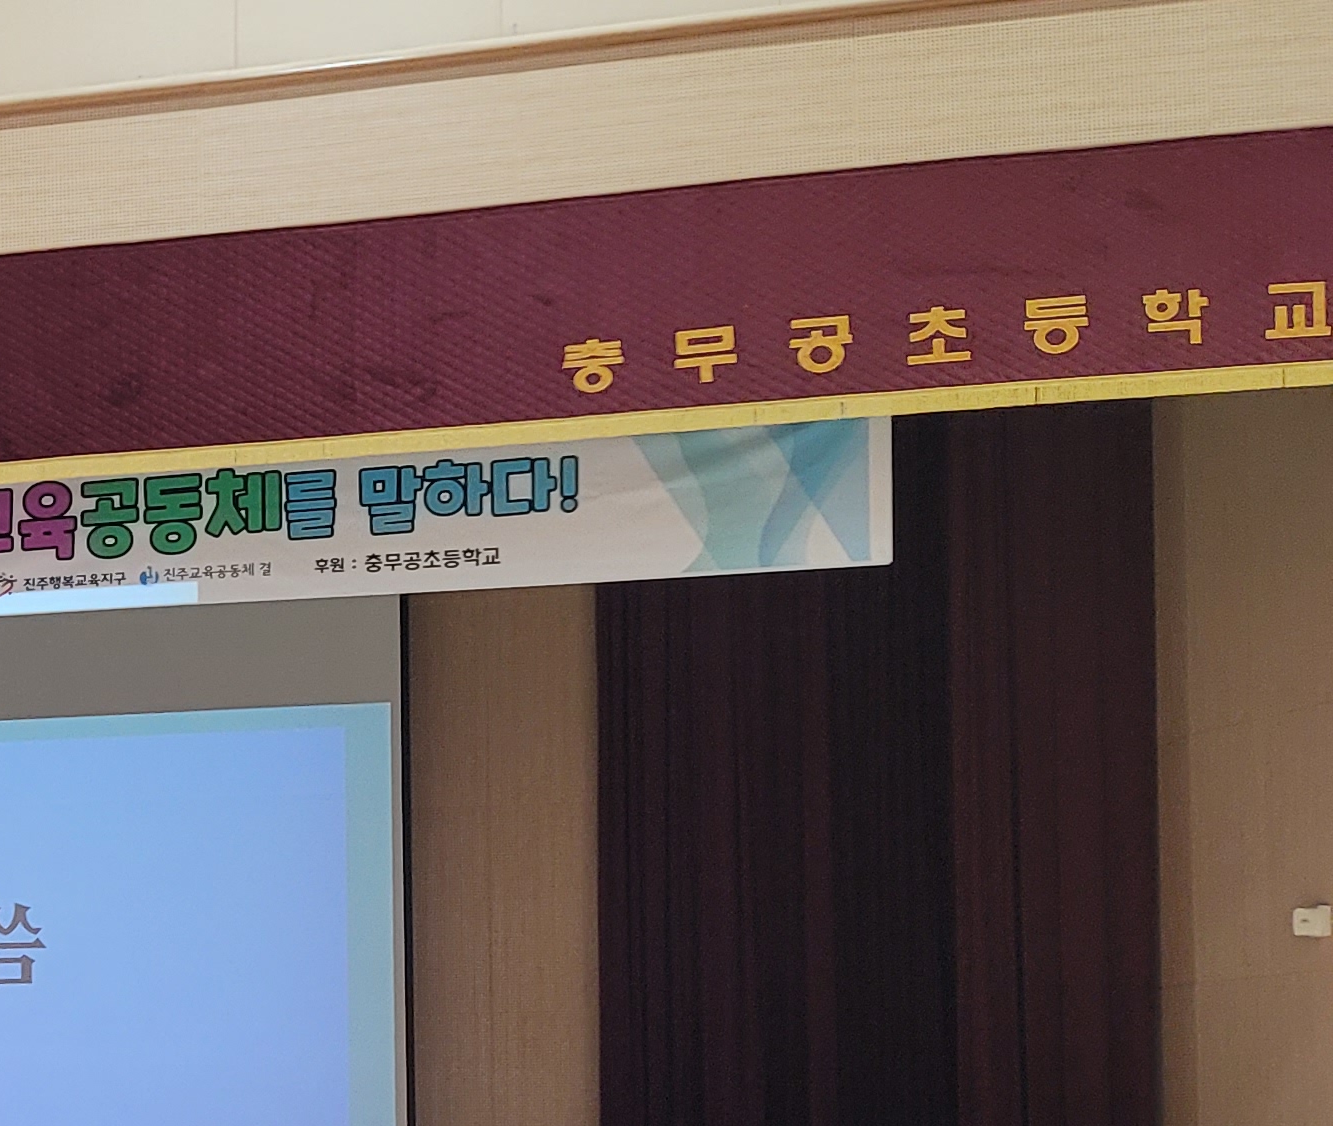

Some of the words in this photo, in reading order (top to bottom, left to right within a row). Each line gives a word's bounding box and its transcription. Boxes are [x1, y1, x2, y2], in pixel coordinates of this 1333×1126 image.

[562, 281, 1332, 394] 충무공초등학교
[358, 455, 580, 541] 말하다!
[22, 572, 127, 592] 진주행복교육지구
[162, 562, 255, 582] 진주교육공동체
[259, 562, 272, 577] 결
[313, 557, 345, 574] 후원
[364, 547, 501, 573] 충무공초등학교
